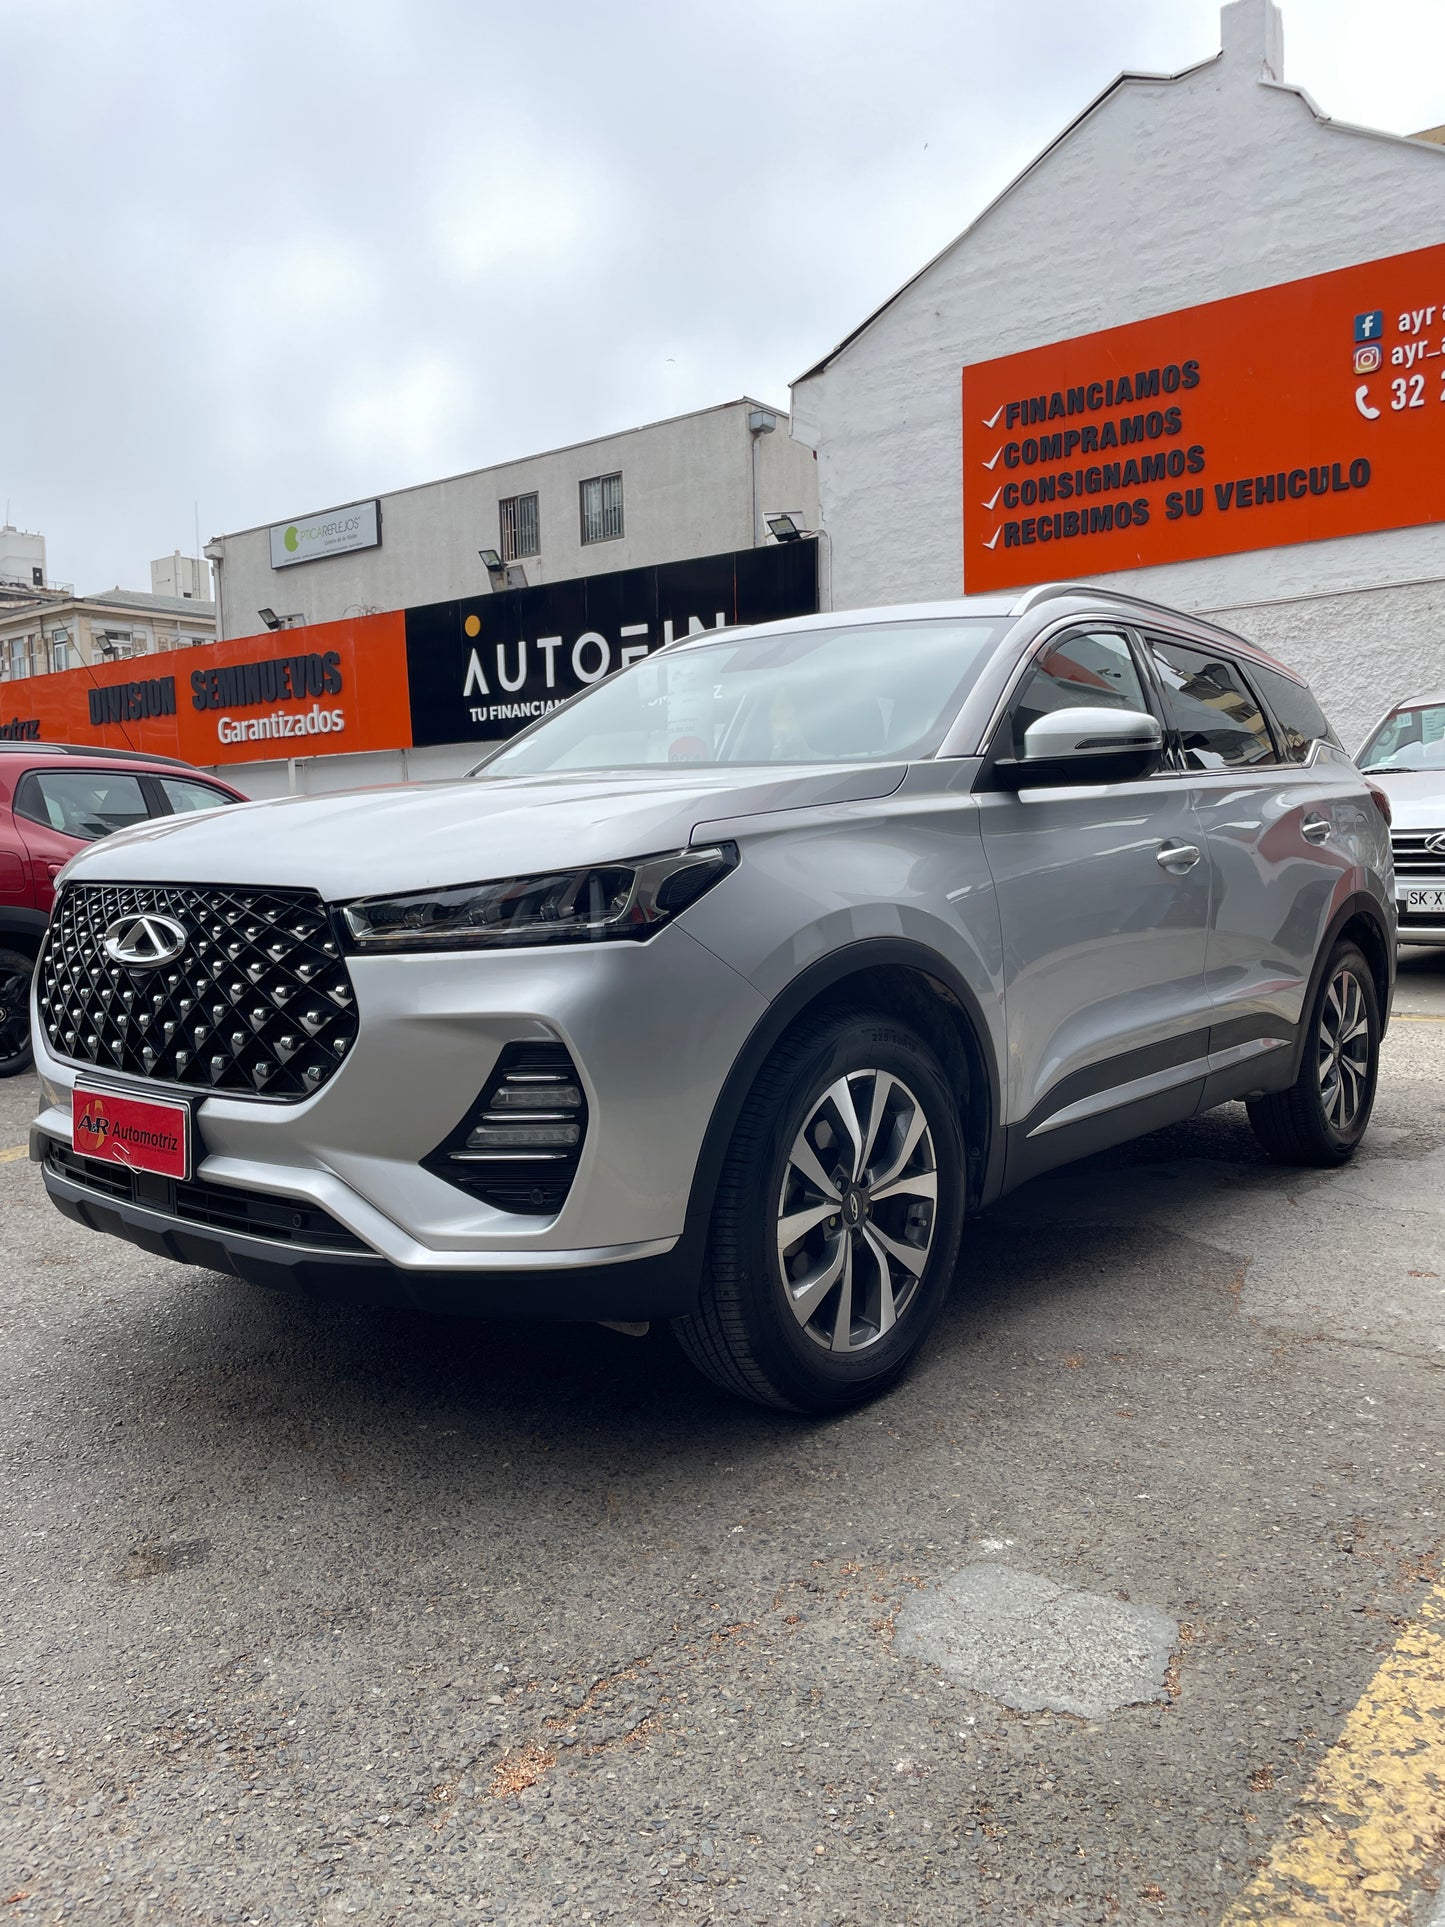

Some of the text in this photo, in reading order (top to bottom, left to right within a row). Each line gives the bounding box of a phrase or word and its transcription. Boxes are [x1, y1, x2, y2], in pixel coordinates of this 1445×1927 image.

[1398, 305, 1437, 335] ayr
[1005, 360, 1200, 430] FINANCIAMOS
[1391, 374, 1425, 411] 32
[1003, 406, 1182, 469] COMPRAMOS
[1003, 445, 1206, 509] CONSIGNAMOS
[1004, 457, 1371, 548] RECIBIMOS SU VEHICULO
[88, 651, 342, 725] DIVISION SEMINUEVOS
[0, 716, 41, 741] otriz
[217, 703, 345, 745] Garantizados
[470, 706, 488, 722] TU
[111, 1122, 178, 1151] Automotriz
